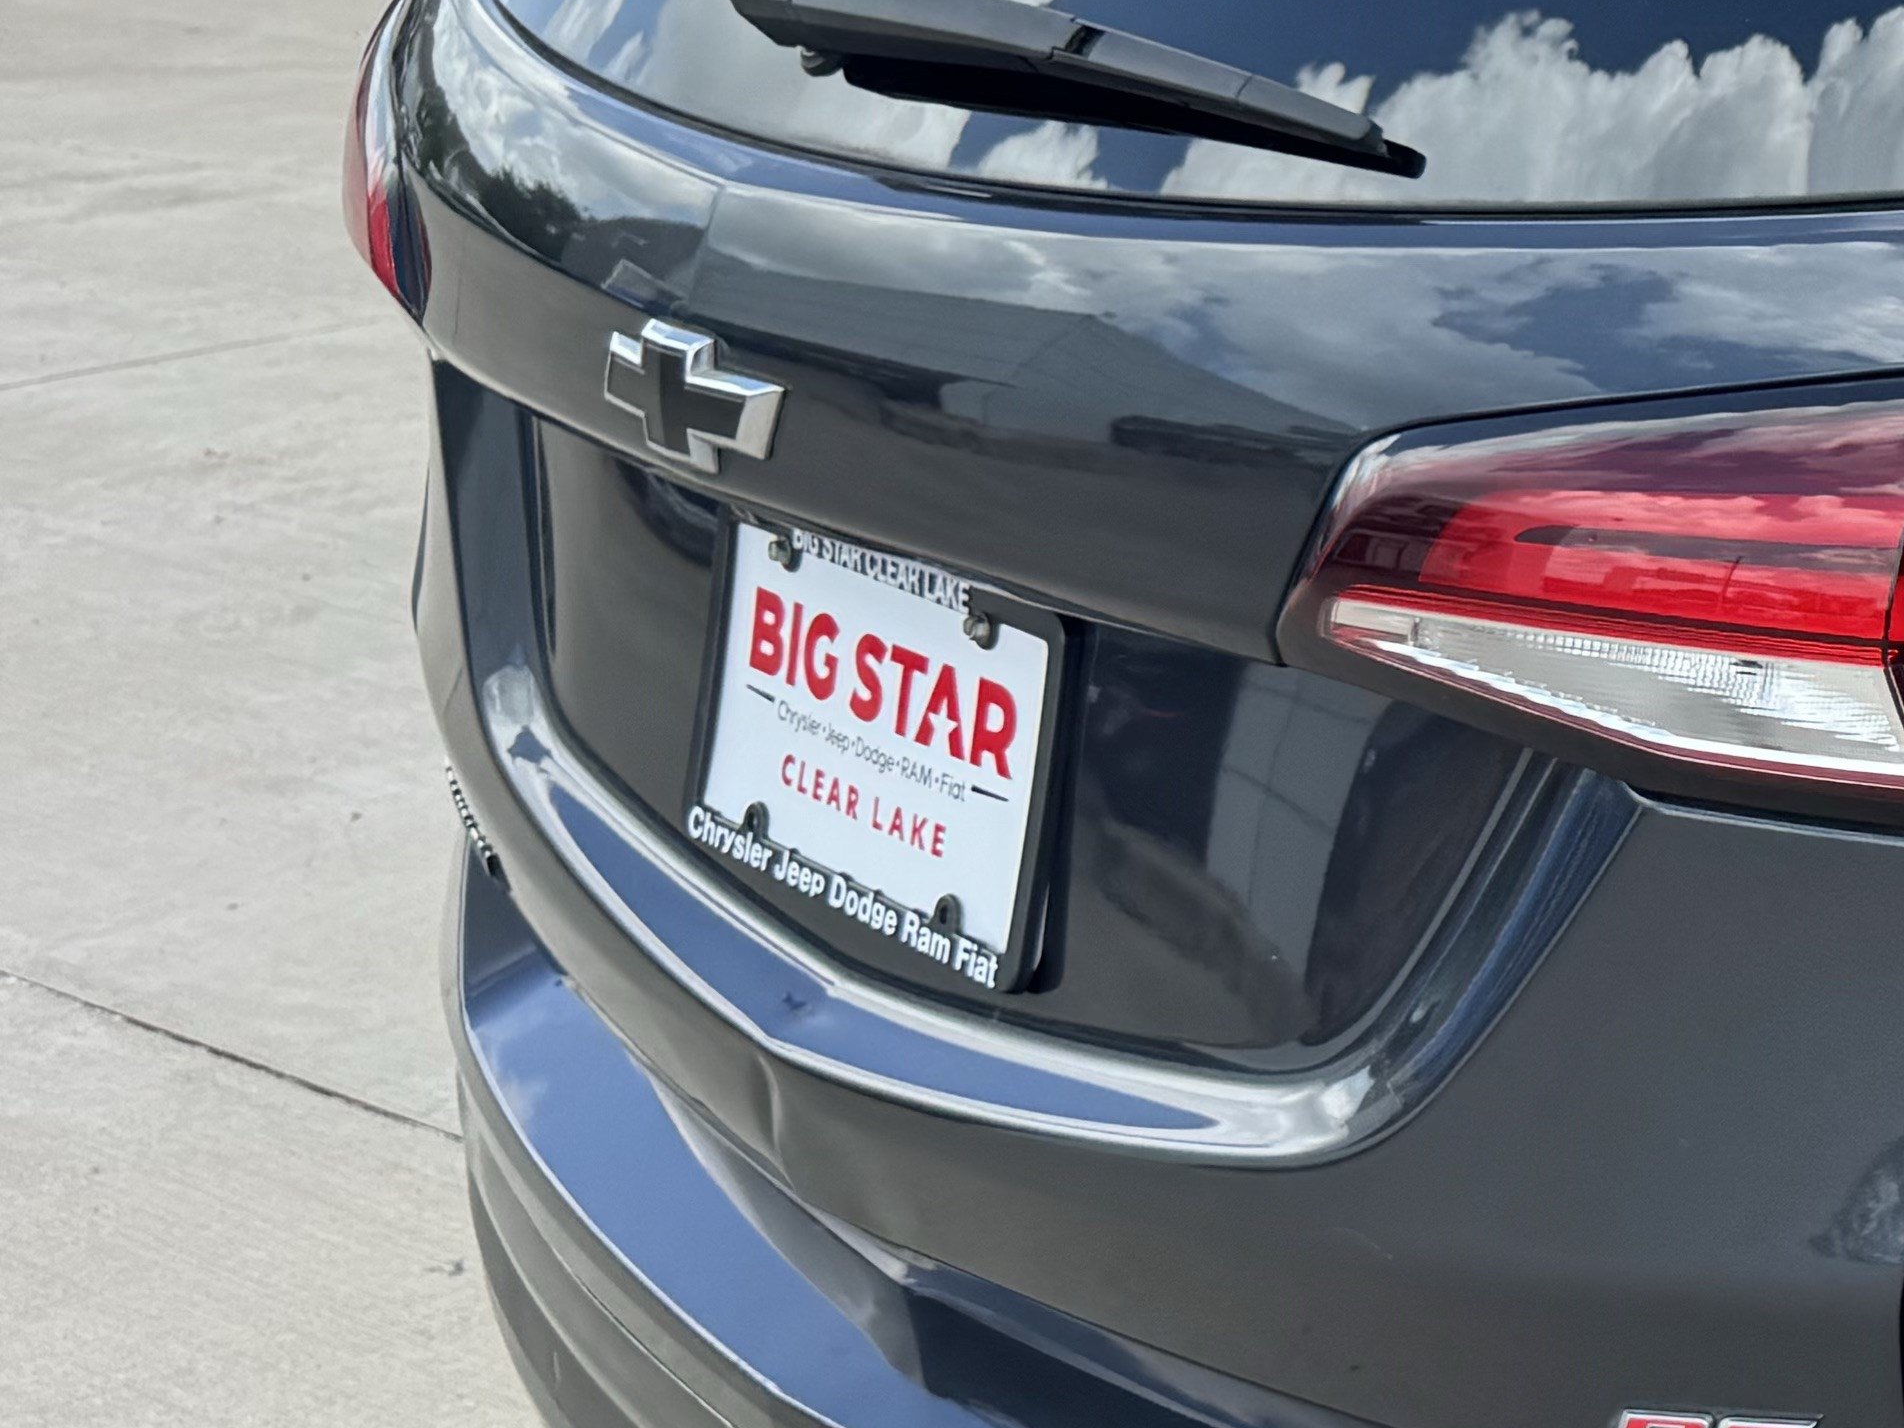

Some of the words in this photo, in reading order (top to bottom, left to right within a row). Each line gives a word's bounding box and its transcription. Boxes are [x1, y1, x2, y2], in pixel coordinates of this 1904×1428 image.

[749, 585, 840, 702] BIG
[849, 633, 1018, 780] STAR
[688, 805, 773, 873] Chrysler
[774, 849, 827, 899] Jeep
[828, 874, 898, 937] Dodge
[901, 910, 951, 965] Ram
[955, 936, 1000, 990] Fiat
[781, 753, 859, 820] CLEAR
[871, 796, 947, 859] LAKE
